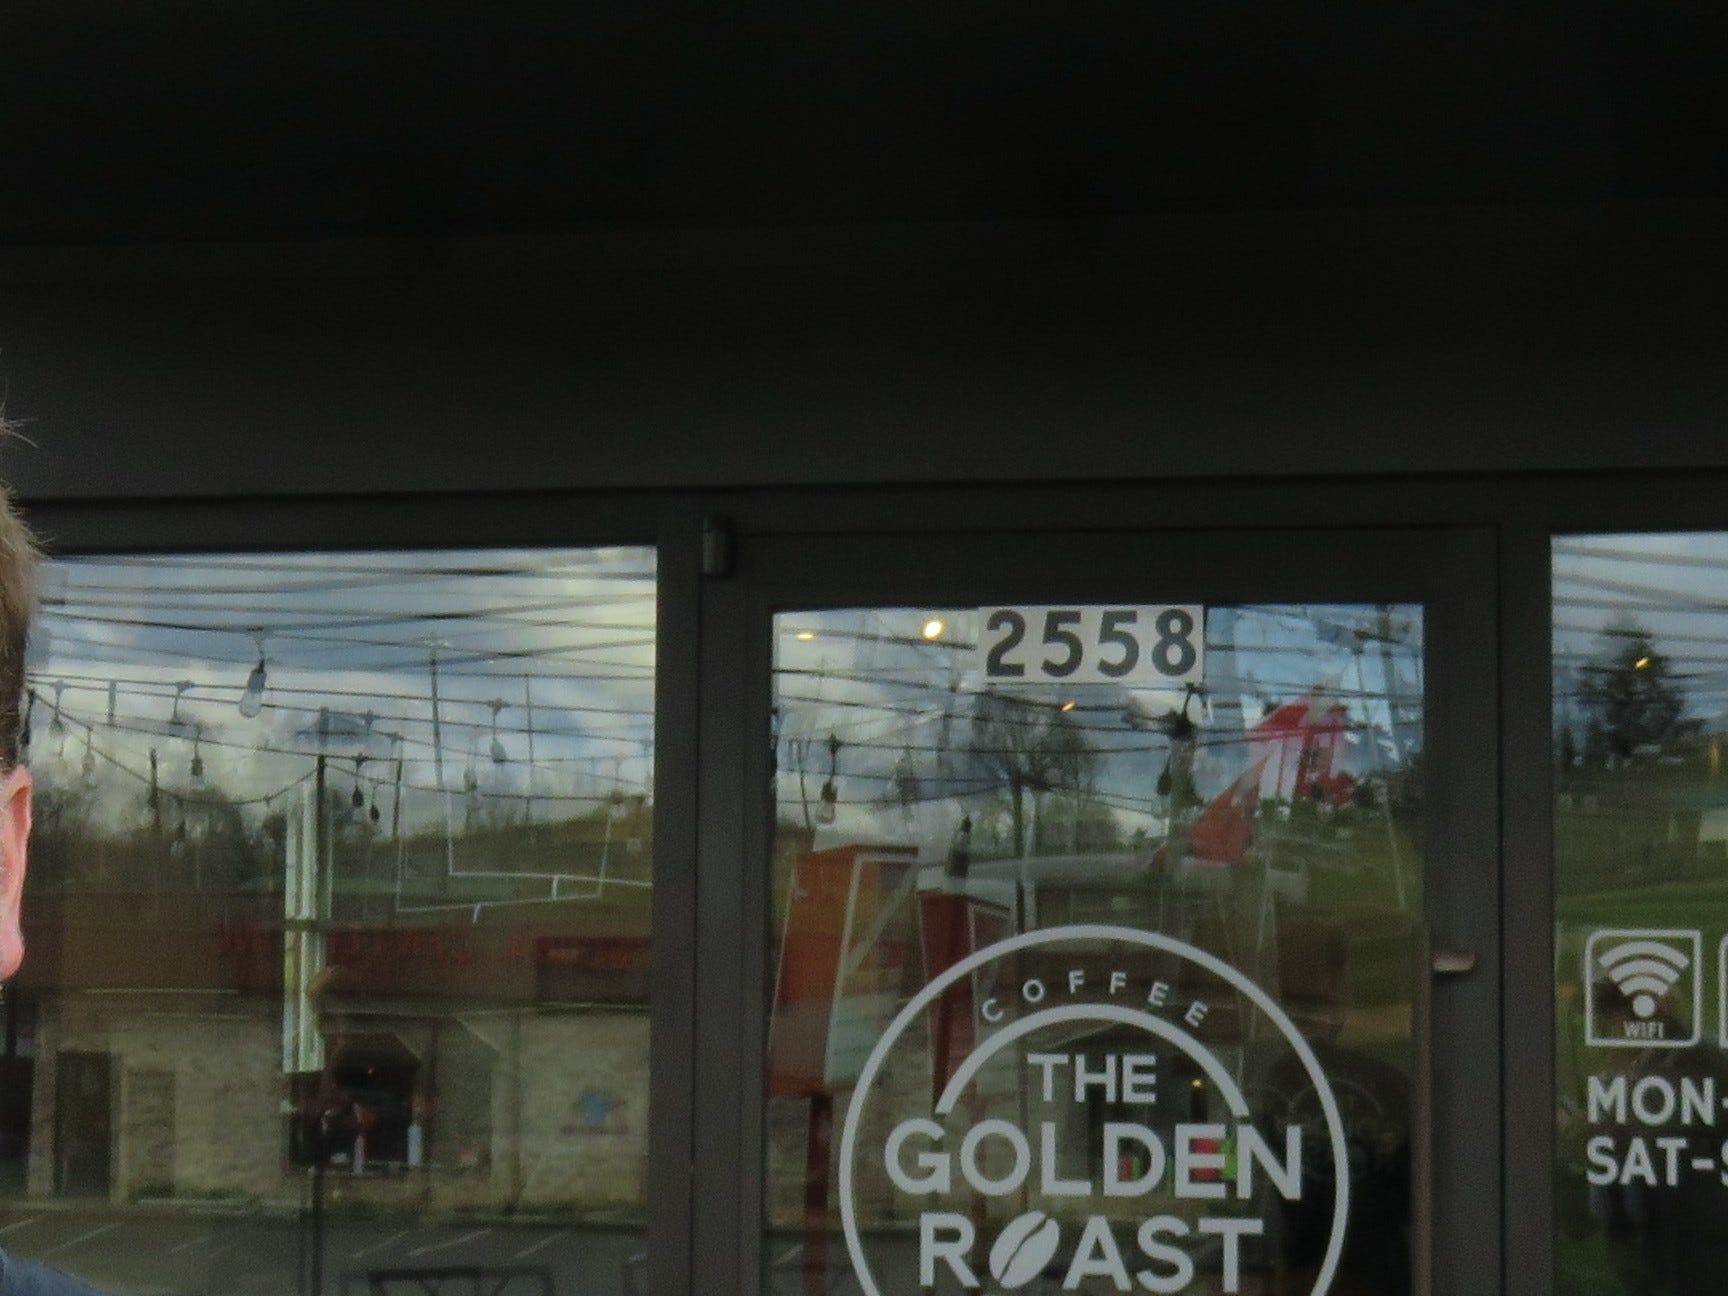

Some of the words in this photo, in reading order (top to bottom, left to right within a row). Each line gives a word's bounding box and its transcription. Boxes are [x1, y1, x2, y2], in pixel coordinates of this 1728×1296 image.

[984, 608, 1198, 678] 2558
[981, 969, 1210, 1029] COFFEE
[1623, 1020, 1665, 1040] WIFI
[1026, 1053, 1157, 1104] THE
[883, 1118, 1303, 1201] GOLDEN
[918, 1210, 1264, 1293] ROAST
